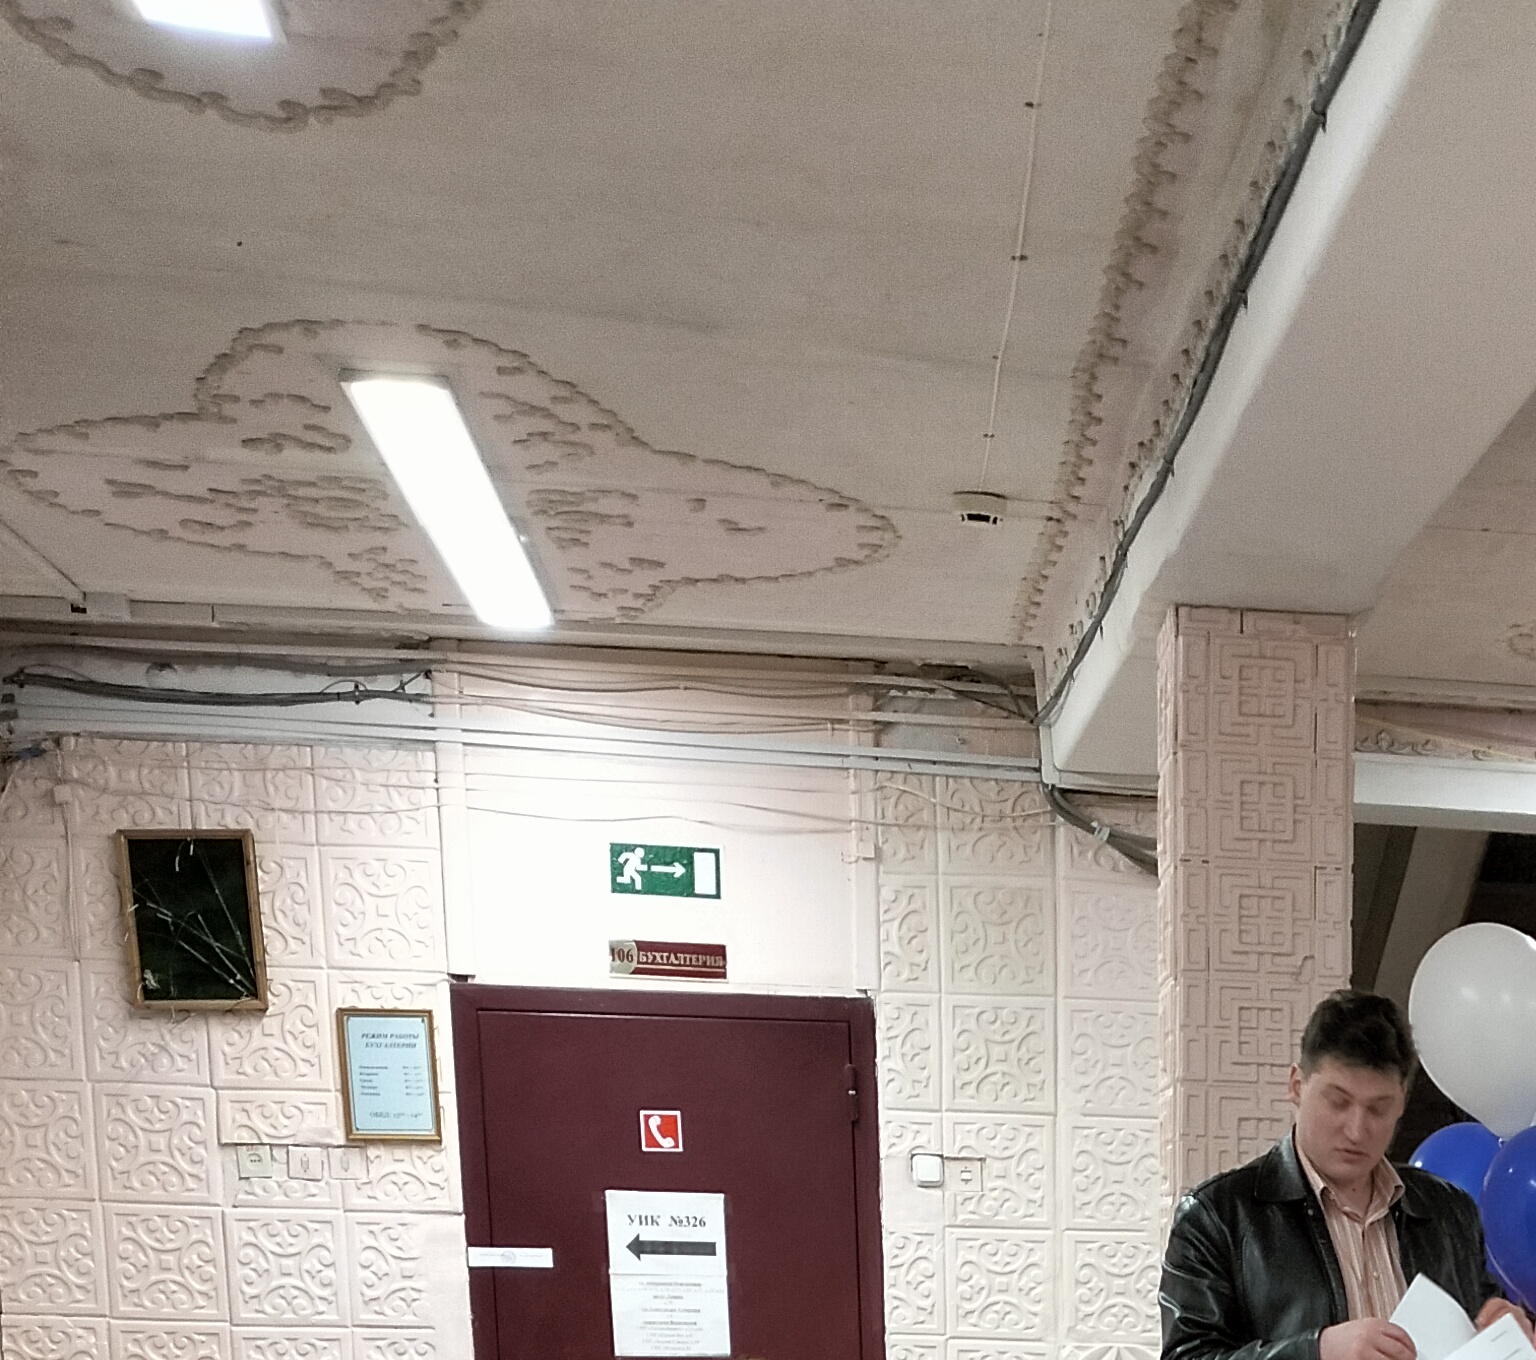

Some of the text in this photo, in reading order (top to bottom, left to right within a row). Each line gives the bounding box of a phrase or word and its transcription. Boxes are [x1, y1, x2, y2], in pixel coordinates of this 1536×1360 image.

[611, 947, 724, 967] 106 БУХГАЛТЕРИЯ
[627, 1214, 707, 1228] УИК №326
